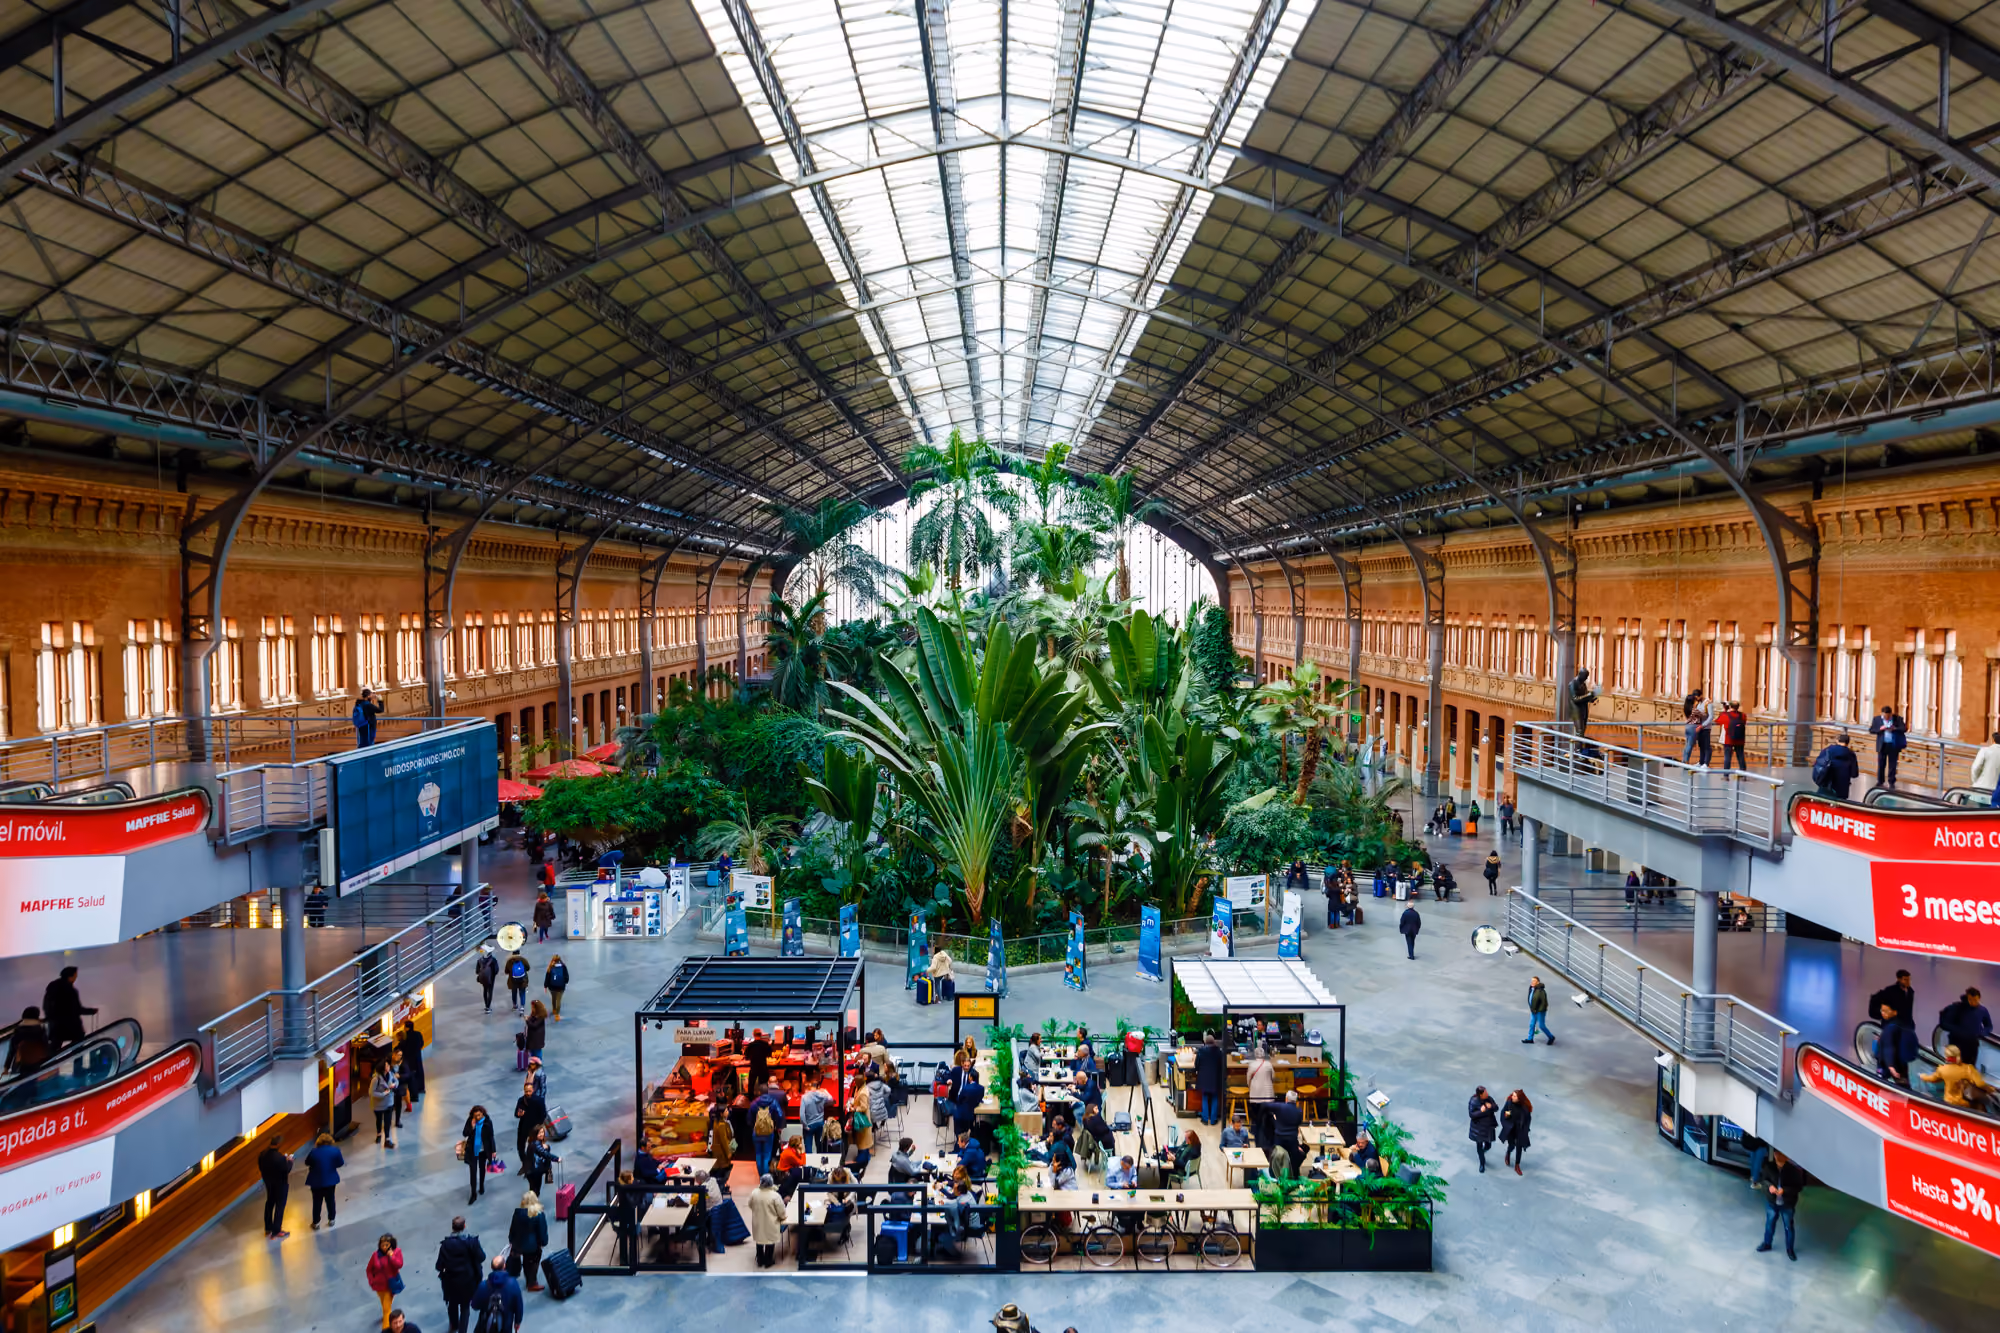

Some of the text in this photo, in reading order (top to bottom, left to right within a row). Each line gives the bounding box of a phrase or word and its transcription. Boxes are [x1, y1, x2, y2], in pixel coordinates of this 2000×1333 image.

[385, 747, 466, 777] UNIDOSPORUNDECIMO.COM
[0, 820, 66, 842] el móvil.
[125, 804, 195, 832] MAPFRE Salud
[1810, 809, 1875, 841] MAPFRE
[1934, 826, 2000, 848] Ahora c
[20, 895, 105, 913] MAPFRE Salud
[1901, 884, 1919, 918] 3
[106, 1056, 190, 1111] PROGRAMA TU FUTURO
[1822, 1065, 1890, 1117] MAPFRE
[59, 1116, 70, 1132] a
[1909, 1109, 1987, 1152] Descubre
[0, 1192, 48, 1216] ROGRAMA
[67, 1171, 101, 1190] FUTURO
[1911, 1175, 1949, 1205] Hasta
[1950, 1177, 1993, 1222] 3%
